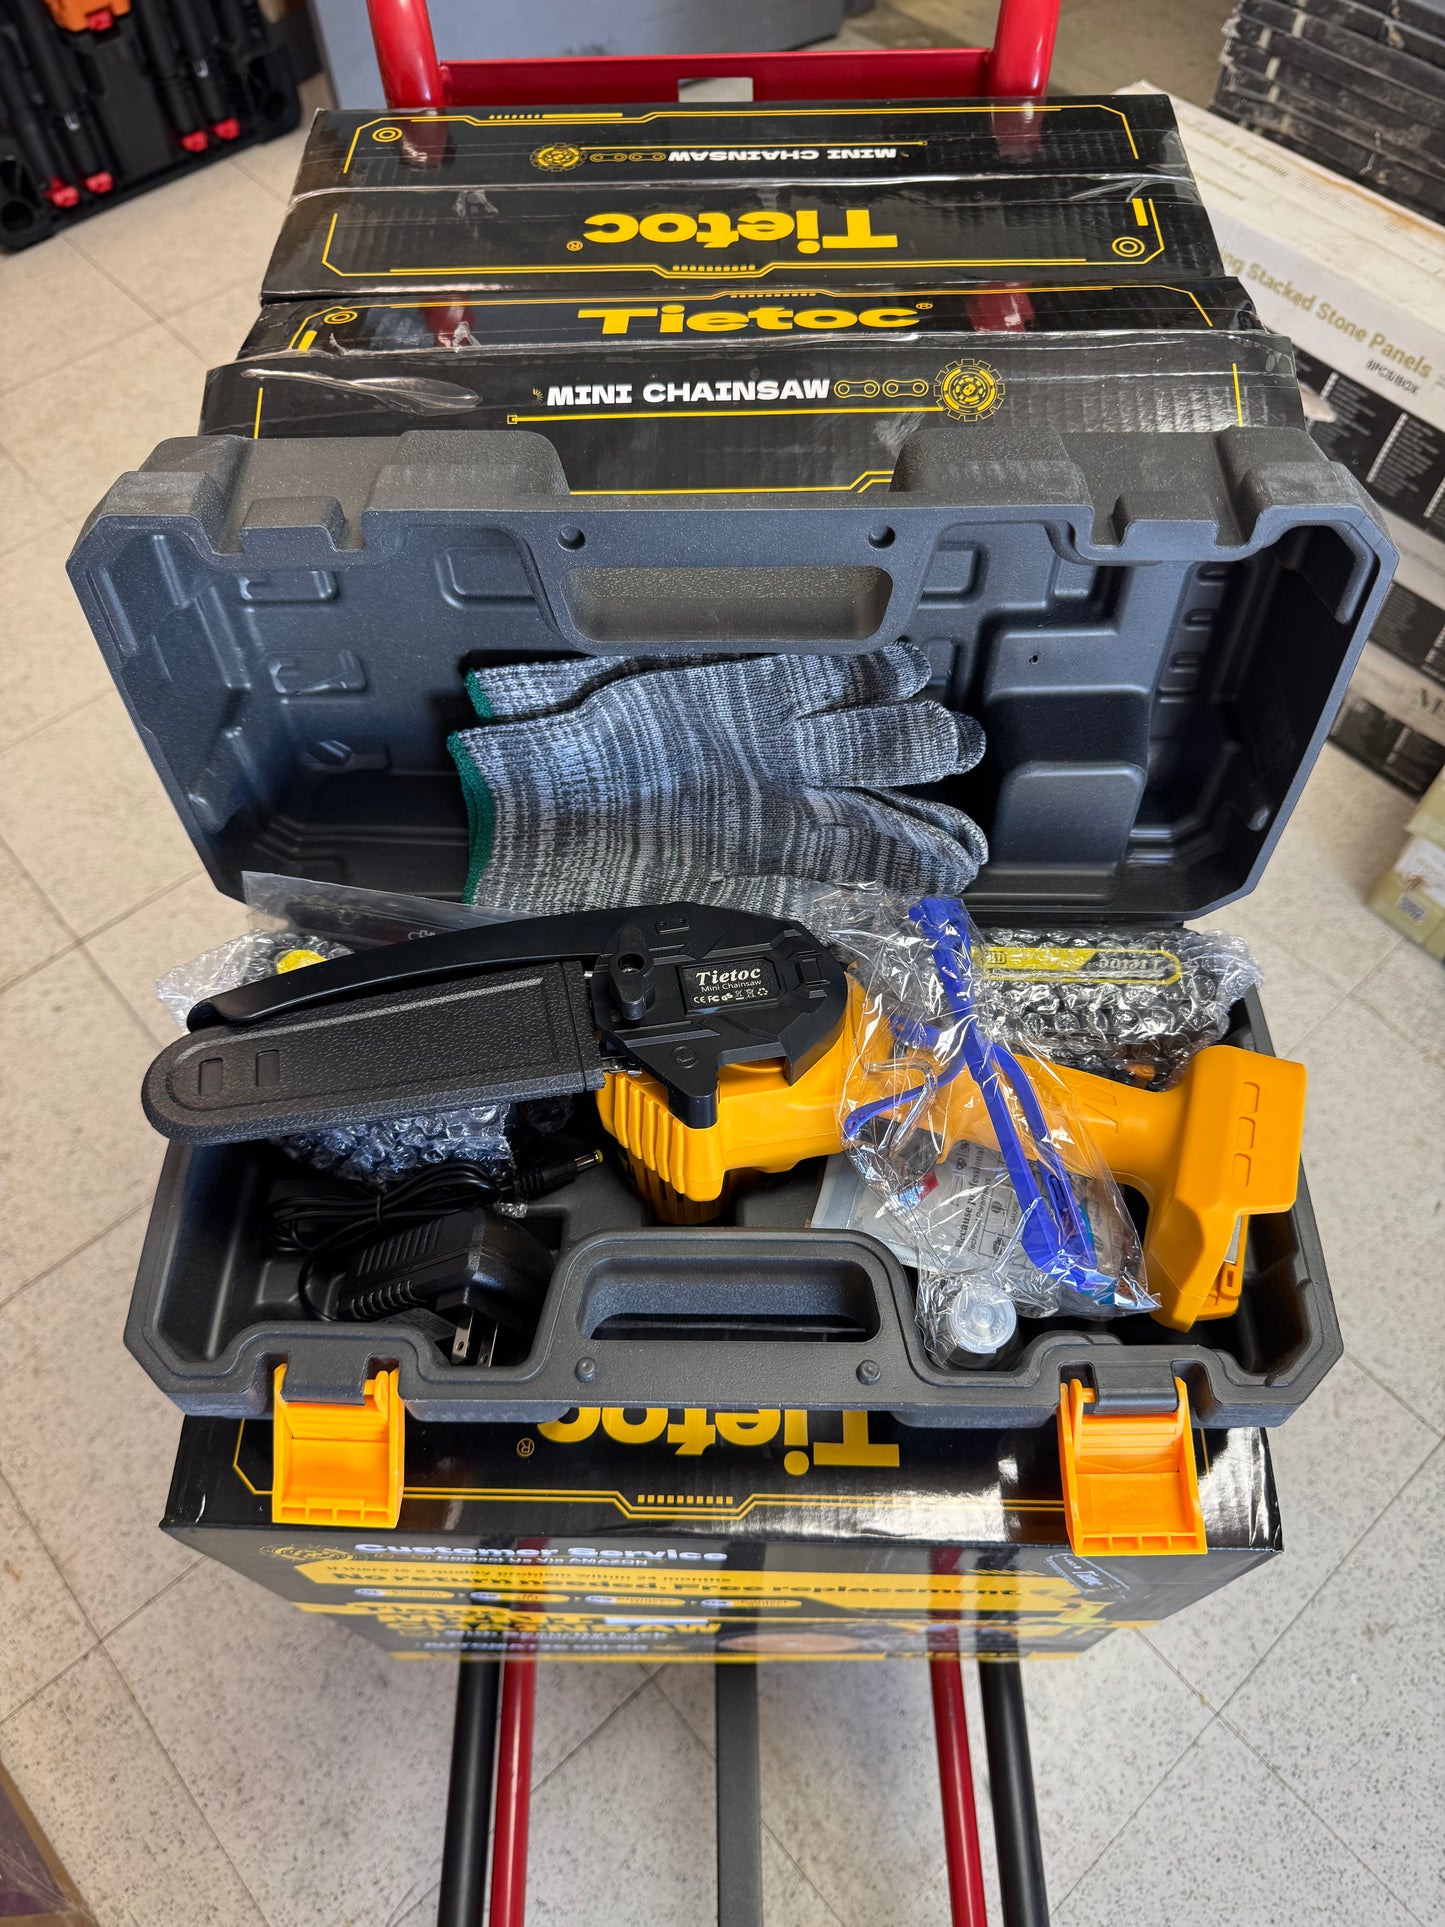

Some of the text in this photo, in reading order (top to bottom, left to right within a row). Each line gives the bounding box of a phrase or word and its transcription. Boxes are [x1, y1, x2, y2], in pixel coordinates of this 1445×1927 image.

[668, 148, 897, 162] MINI CHAINSAW
[1247, 262, 1317, 311] Stacked
[1315, 301, 1368, 342] Stone
[1367, 332, 1433, 380] Panels
[547, 378, 830, 406] MINI CHAINSAW
[695, 968, 761, 986] Tietoc
[701, 979, 762, 993] Mini Chainsaw
[955, 1206, 973, 1248] Because
[354, 1544, 728, 1562] Customer Service
